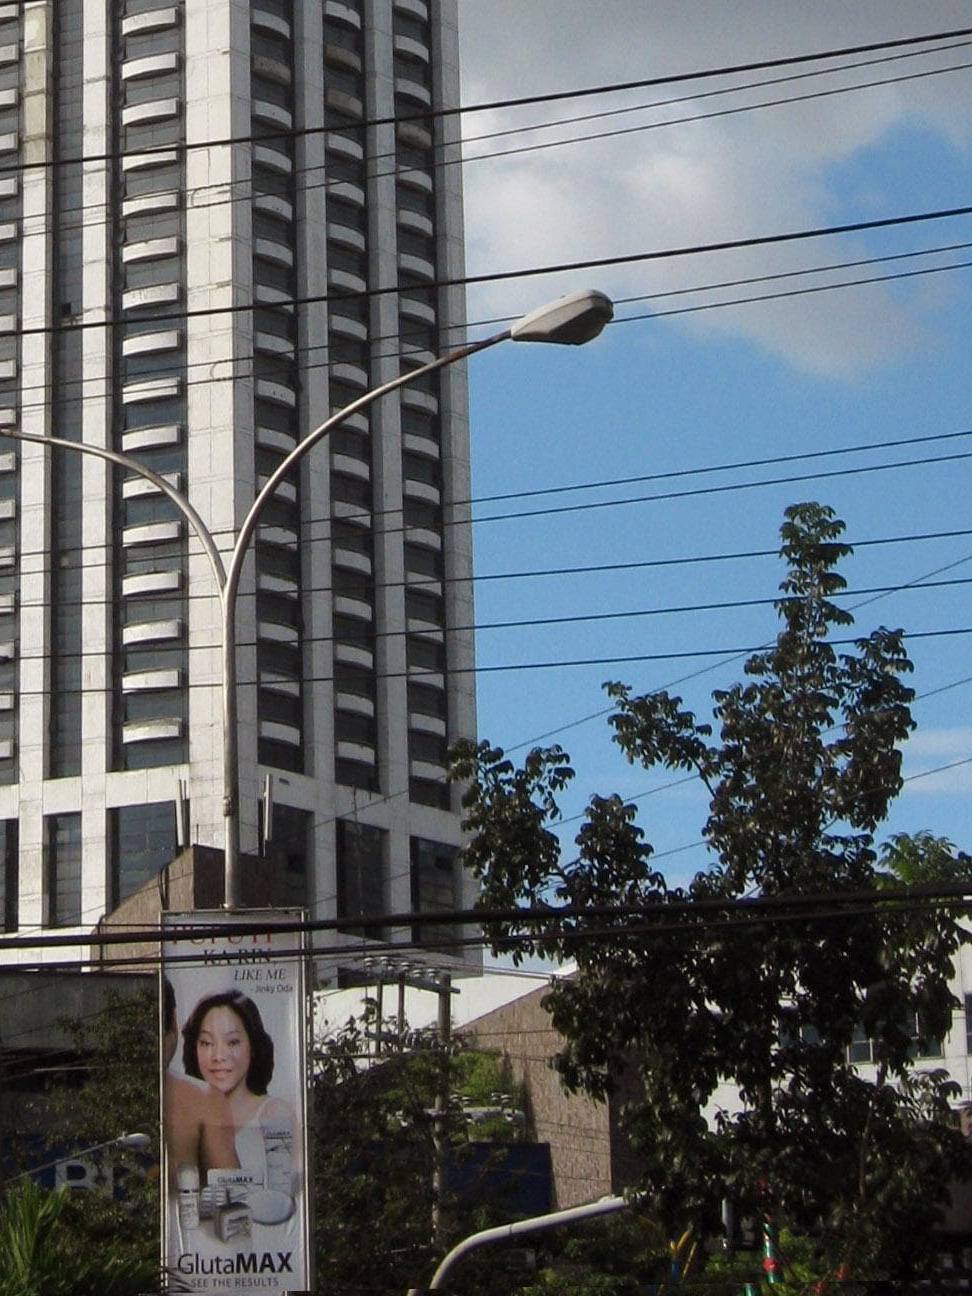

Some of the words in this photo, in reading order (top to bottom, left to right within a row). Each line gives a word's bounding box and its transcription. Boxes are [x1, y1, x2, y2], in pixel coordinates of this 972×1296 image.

[234, 969, 263, 981] LIKE
[266, 968, 287, 980] ME
[177, 1252, 293, 1275] GlutaMAX
[191, 1279, 208, 1288] SEE
[213, 1278, 232, 1288] THE
[235, 1277, 279, 1288] RESULTS
